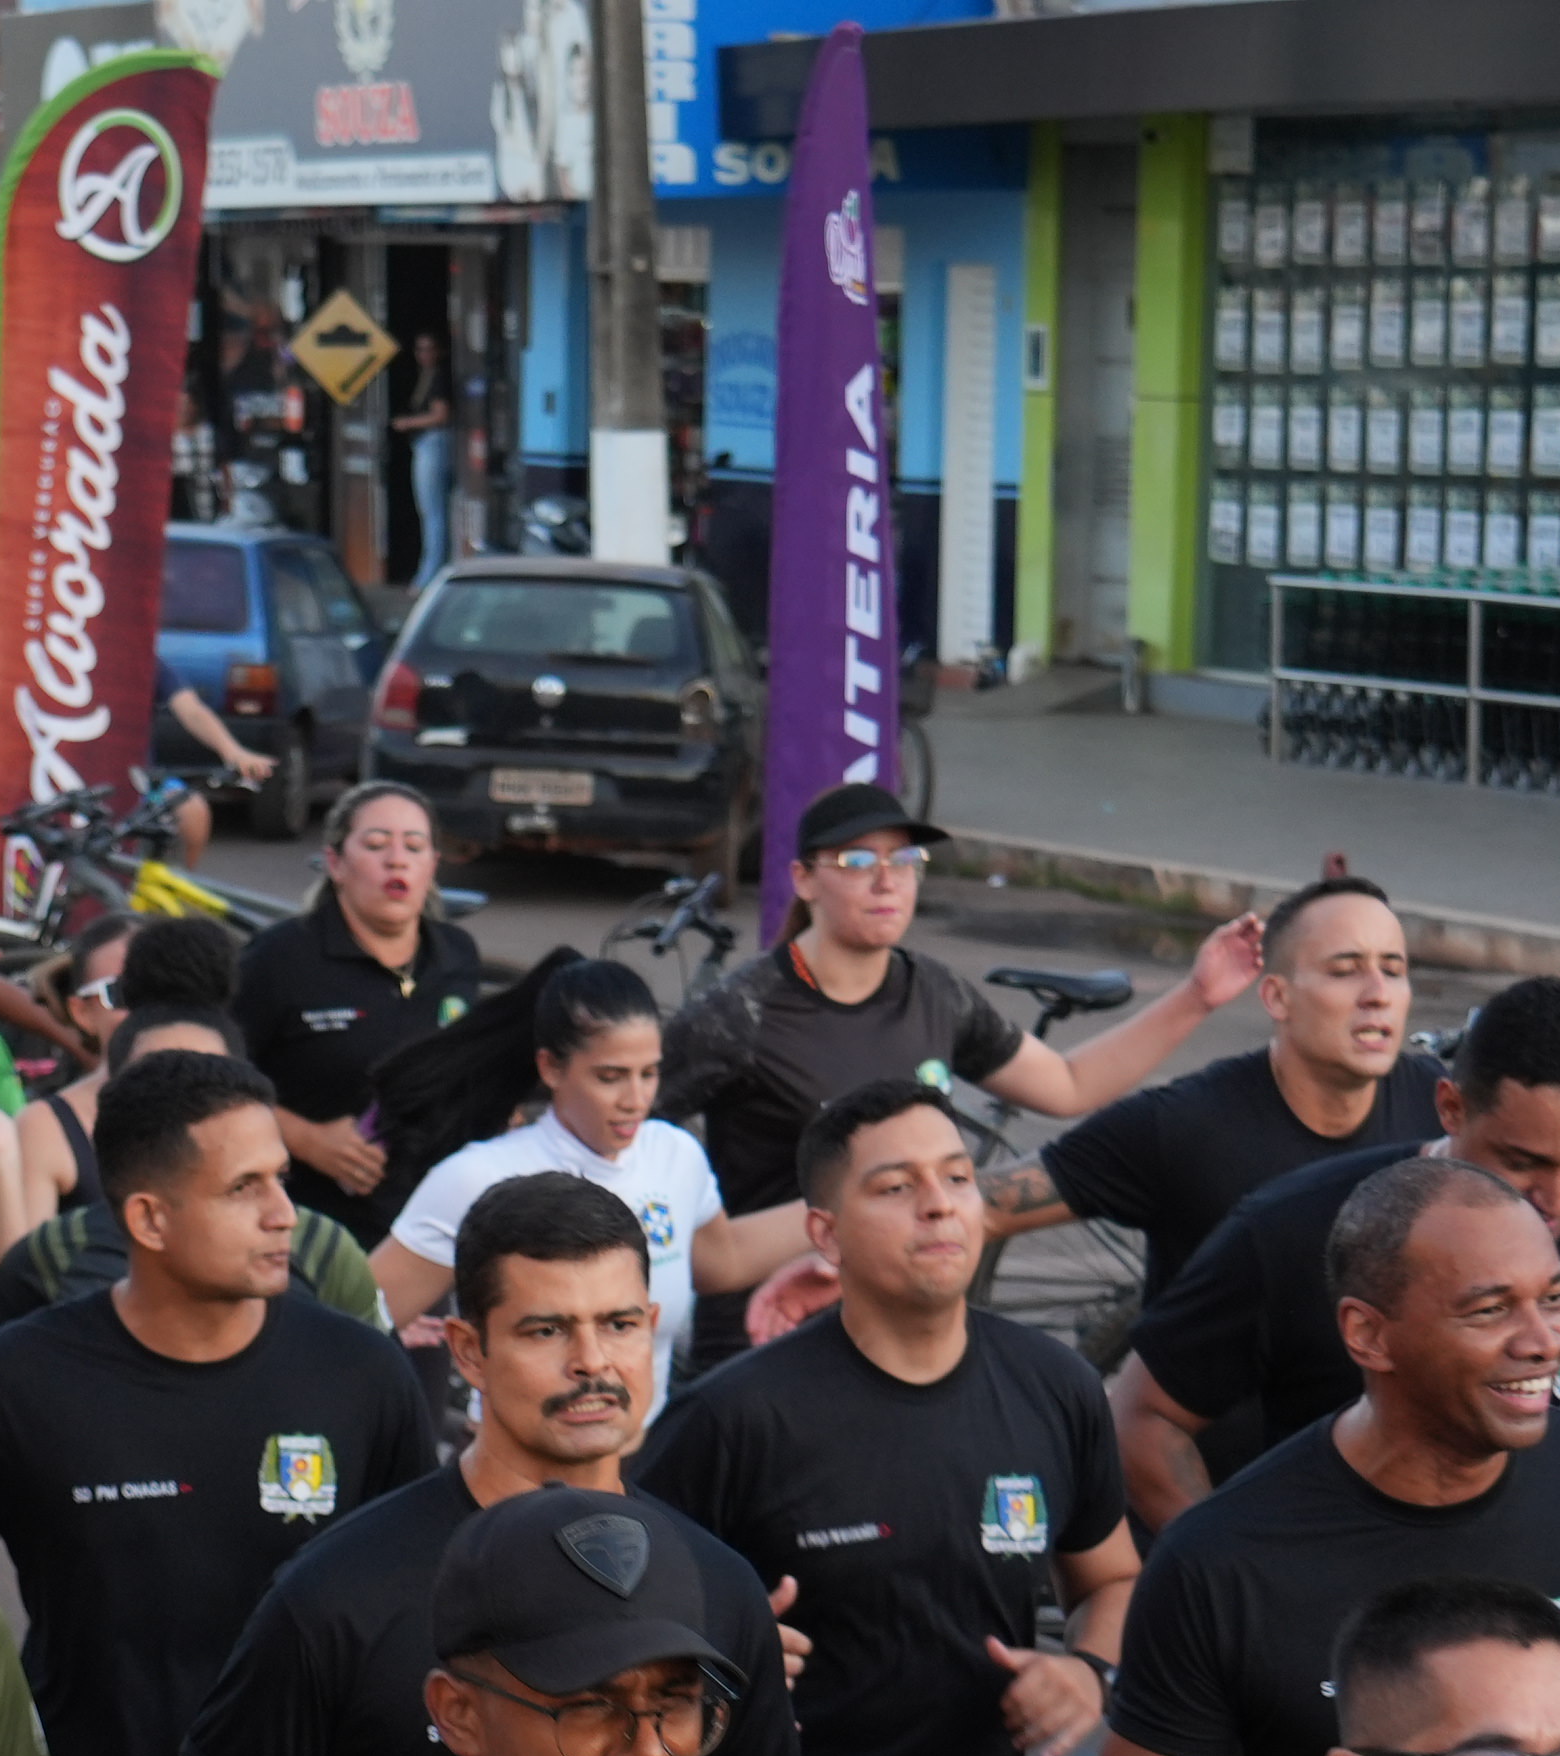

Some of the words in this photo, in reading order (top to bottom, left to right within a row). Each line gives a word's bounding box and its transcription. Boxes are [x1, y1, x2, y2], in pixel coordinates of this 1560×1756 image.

[713, 140, 901, 186] SOA
[13, 302, 130, 802] Alvorada
[95, 1483, 119, 1502] PM
